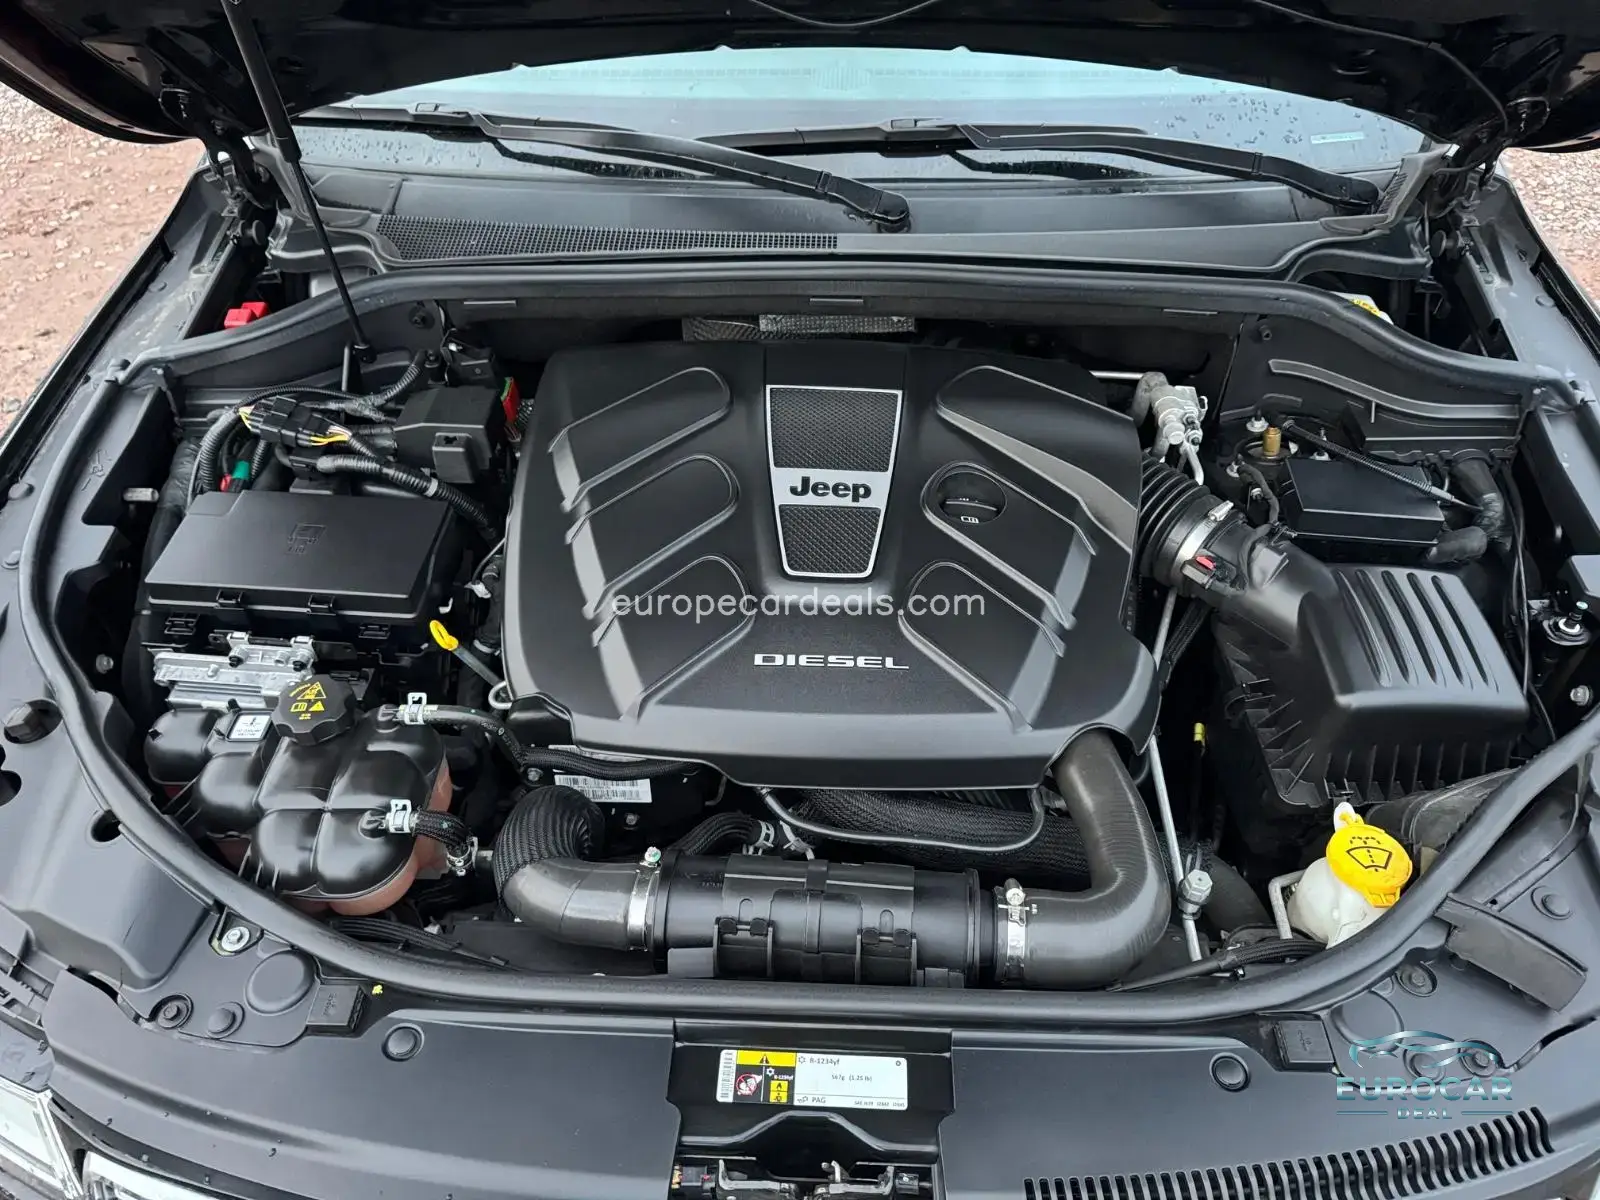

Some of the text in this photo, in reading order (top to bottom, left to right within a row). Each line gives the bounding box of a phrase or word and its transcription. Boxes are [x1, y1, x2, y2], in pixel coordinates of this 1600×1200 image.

[789, 476, 872, 503] Jeep
[753, 653, 909, 669] DIESEL
[809, 1057, 840, 1066] R-1234yf
[811, 1096, 826, 1104] PAG
